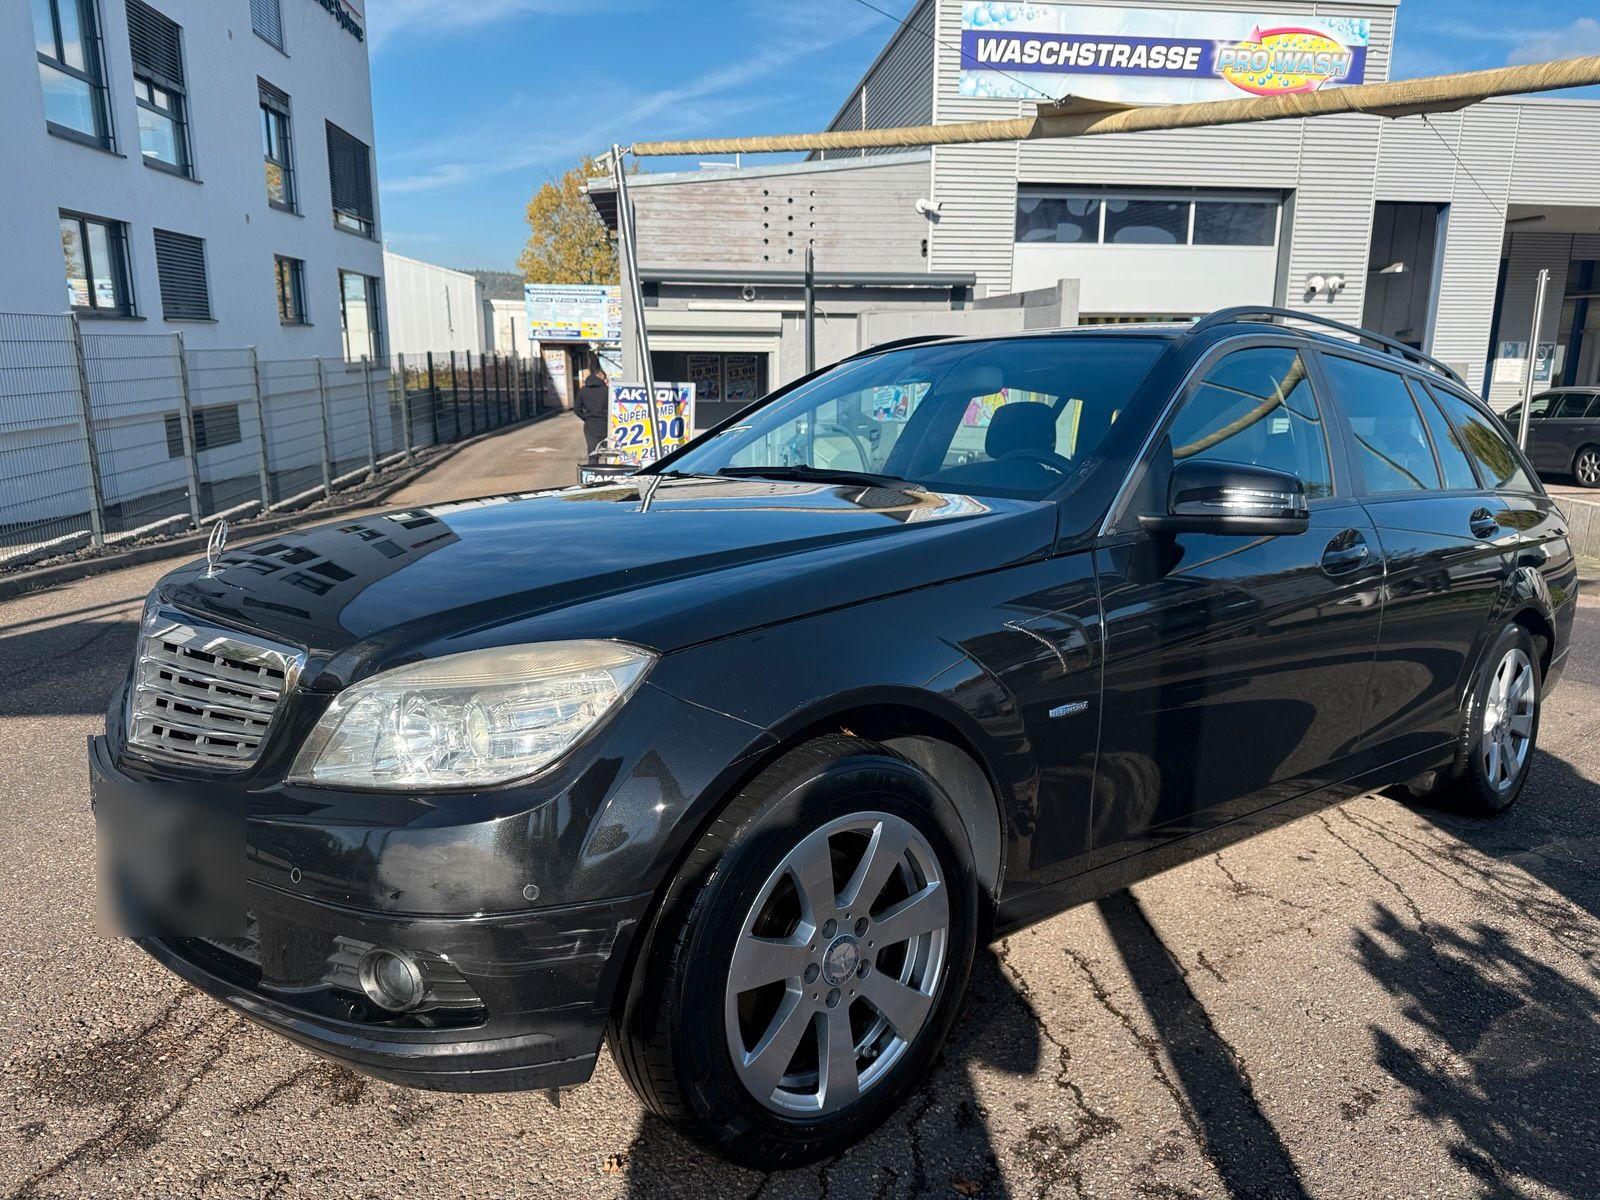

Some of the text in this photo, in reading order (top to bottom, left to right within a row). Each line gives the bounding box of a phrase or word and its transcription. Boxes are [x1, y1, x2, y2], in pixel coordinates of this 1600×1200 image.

[976, 38, 1202, 71] WASCHSTRASSE
[1215, 47, 1352, 77] PRO WASH
